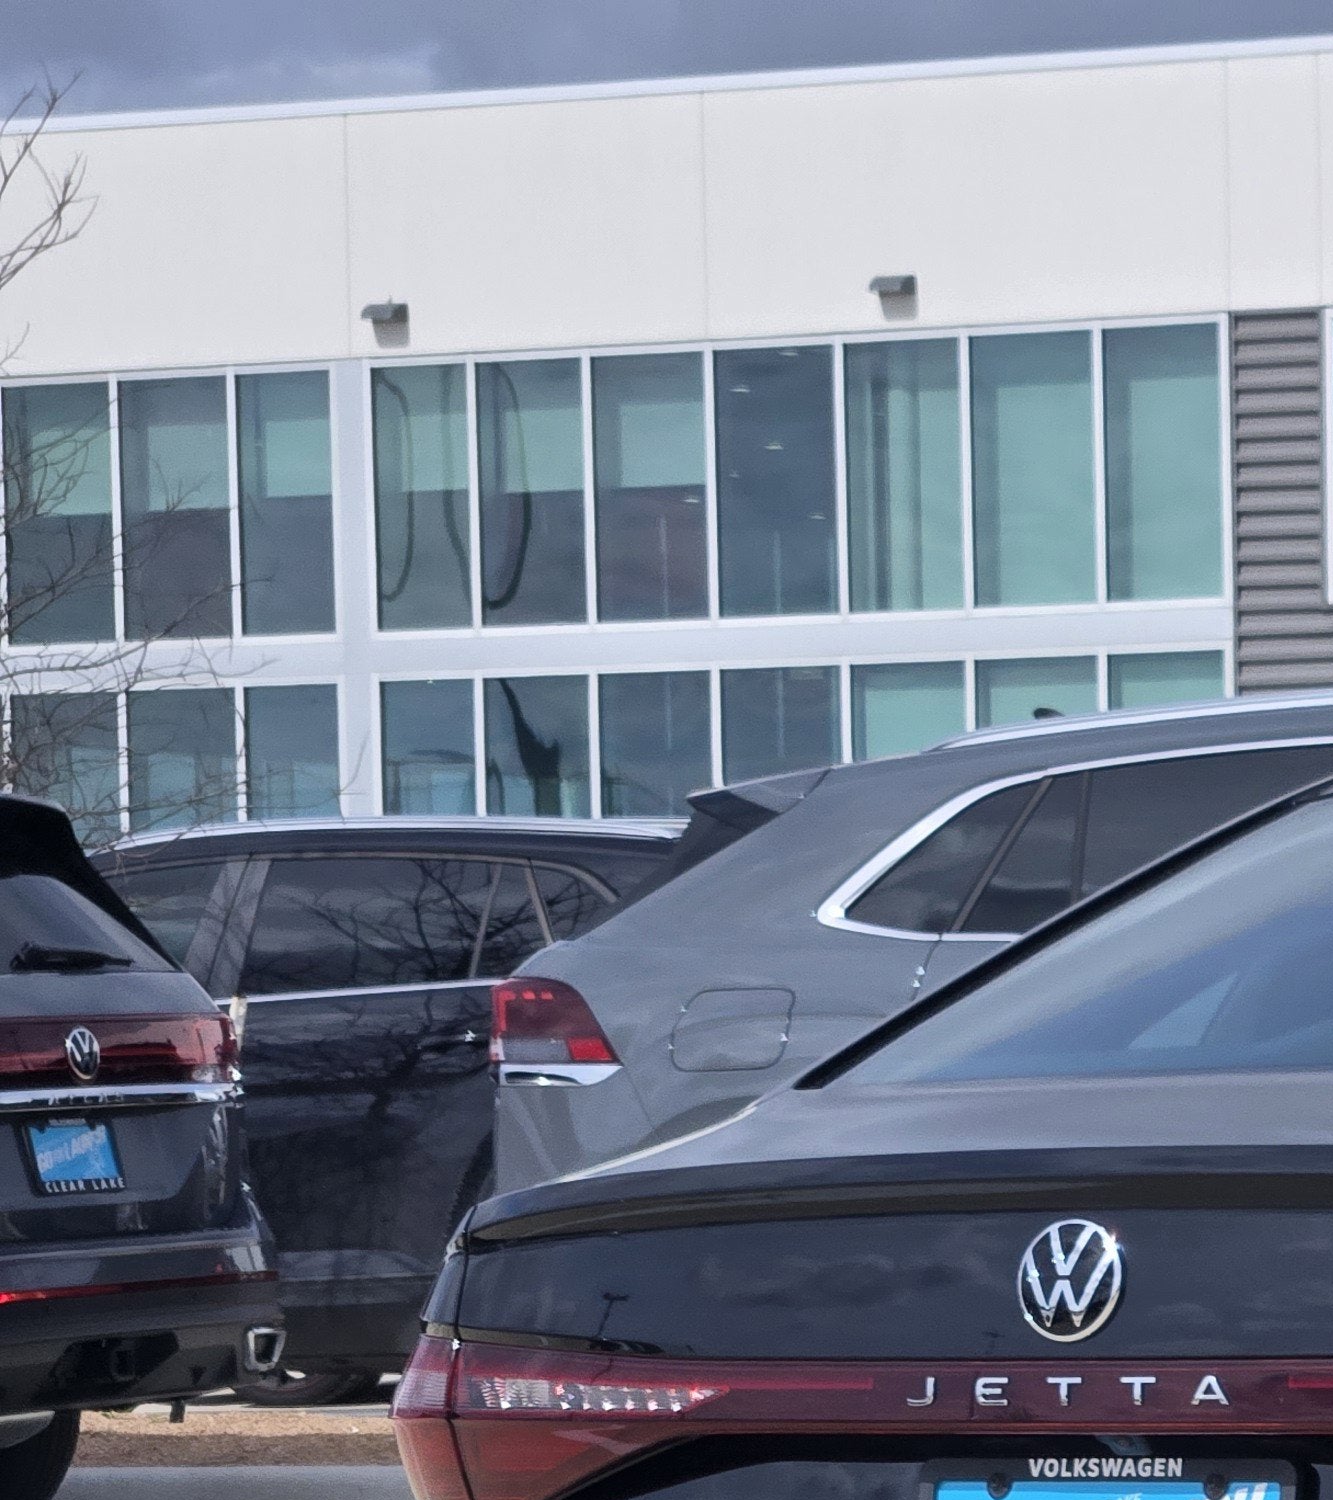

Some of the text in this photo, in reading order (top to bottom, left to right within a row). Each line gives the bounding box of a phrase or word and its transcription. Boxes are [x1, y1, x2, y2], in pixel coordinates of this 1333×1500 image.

[45, 1177, 125, 1193] CLEAR LAKE
[906, 1375, 1230, 1407] JETTA
[1028, 1457, 1184, 1479] VOLKSWAGEN
